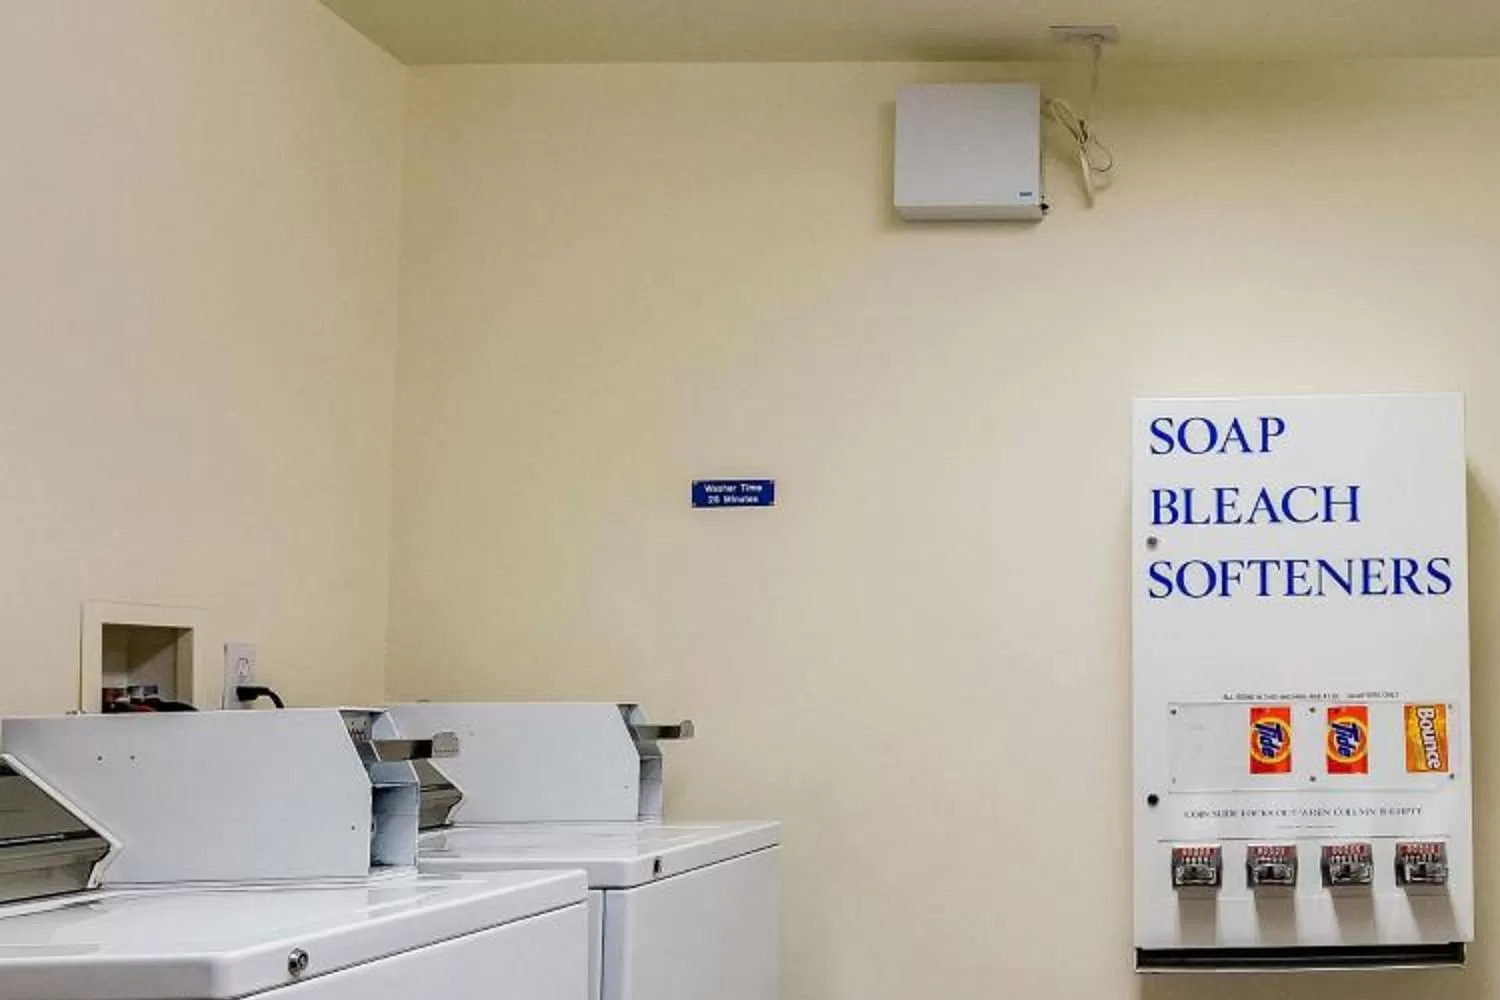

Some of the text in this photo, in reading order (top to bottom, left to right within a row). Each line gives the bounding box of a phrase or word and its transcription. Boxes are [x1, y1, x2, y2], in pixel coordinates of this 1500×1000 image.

[1149, 416, 1286, 455] SOAP
[723, 494, 759, 504] Minutes
[740, 482, 763, 493] Time
[1150, 485, 1361, 525] BLEACH
[1148, 556, 1453, 598] SOFTENERS
[1255, 722, 1284, 758] Tide
[1331, 722, 1361, 758] Tide
